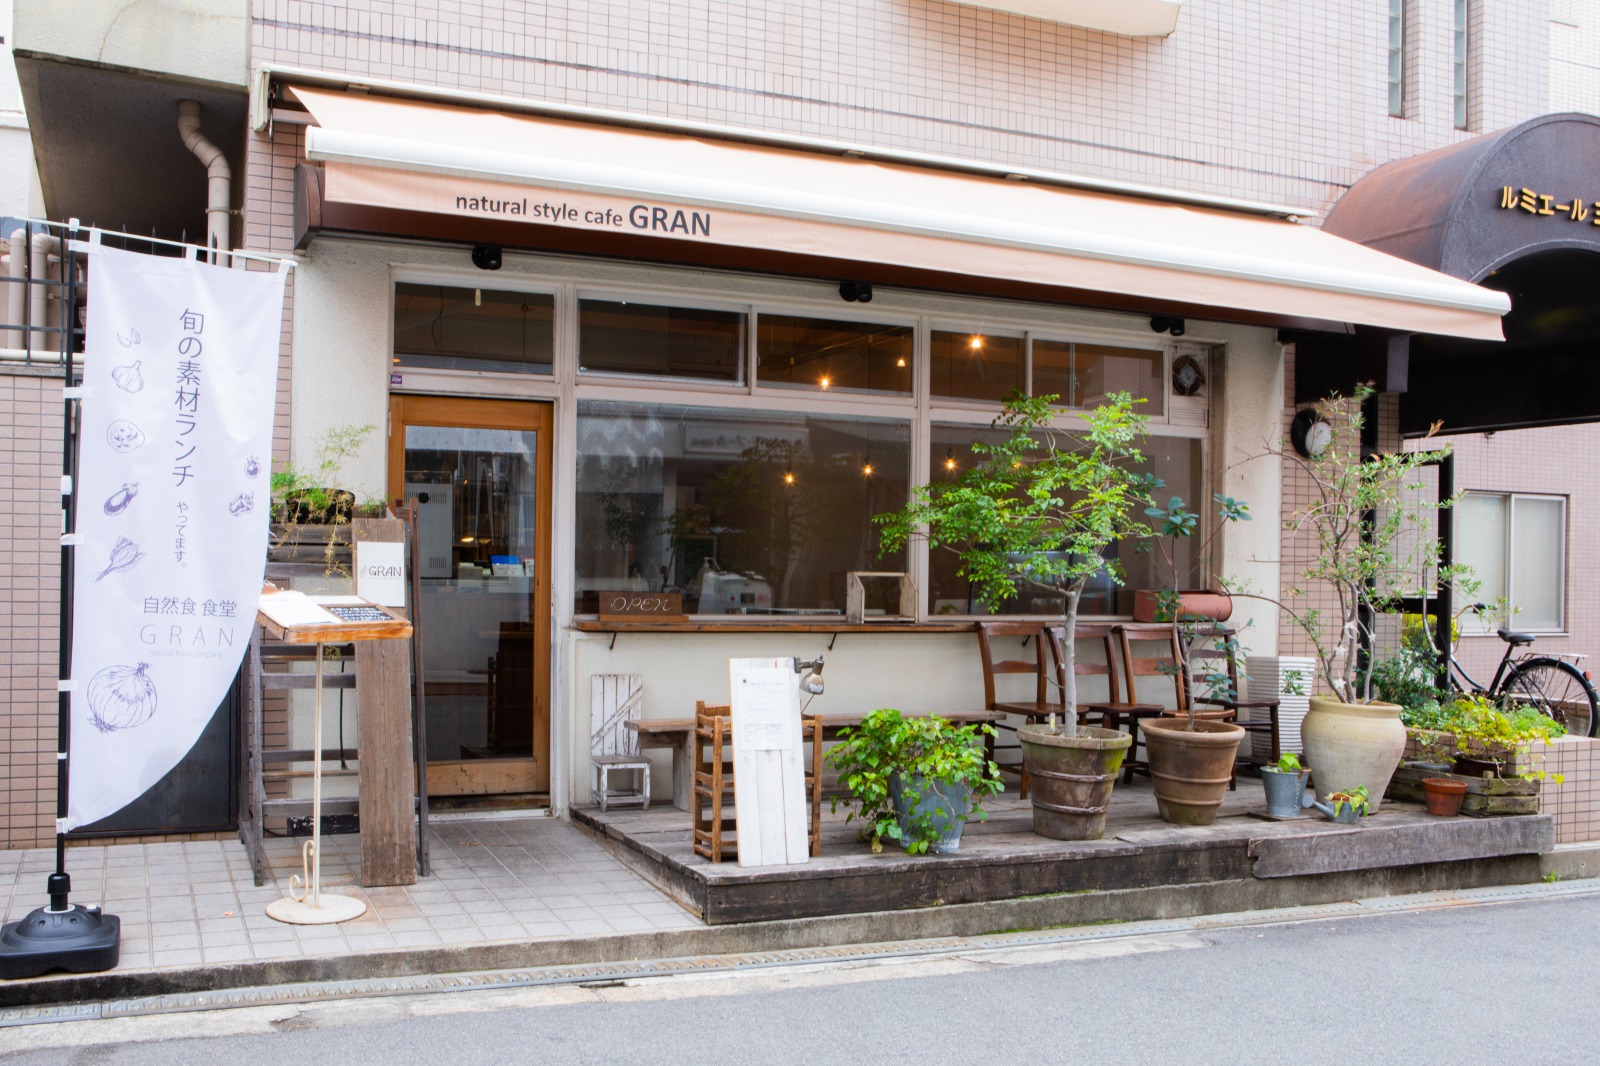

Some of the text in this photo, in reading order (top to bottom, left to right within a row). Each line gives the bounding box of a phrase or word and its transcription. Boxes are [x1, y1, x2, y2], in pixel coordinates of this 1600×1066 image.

[456, 195, 711, 236] natural style cafe GRAN
[172, 308, 204, 568] 旬の素材ランチ やってます。
[368, 565, 402, 577] GRAN
[610, 597, 671, 611] OPEN
[140, 624, 234, 646] GRAN
